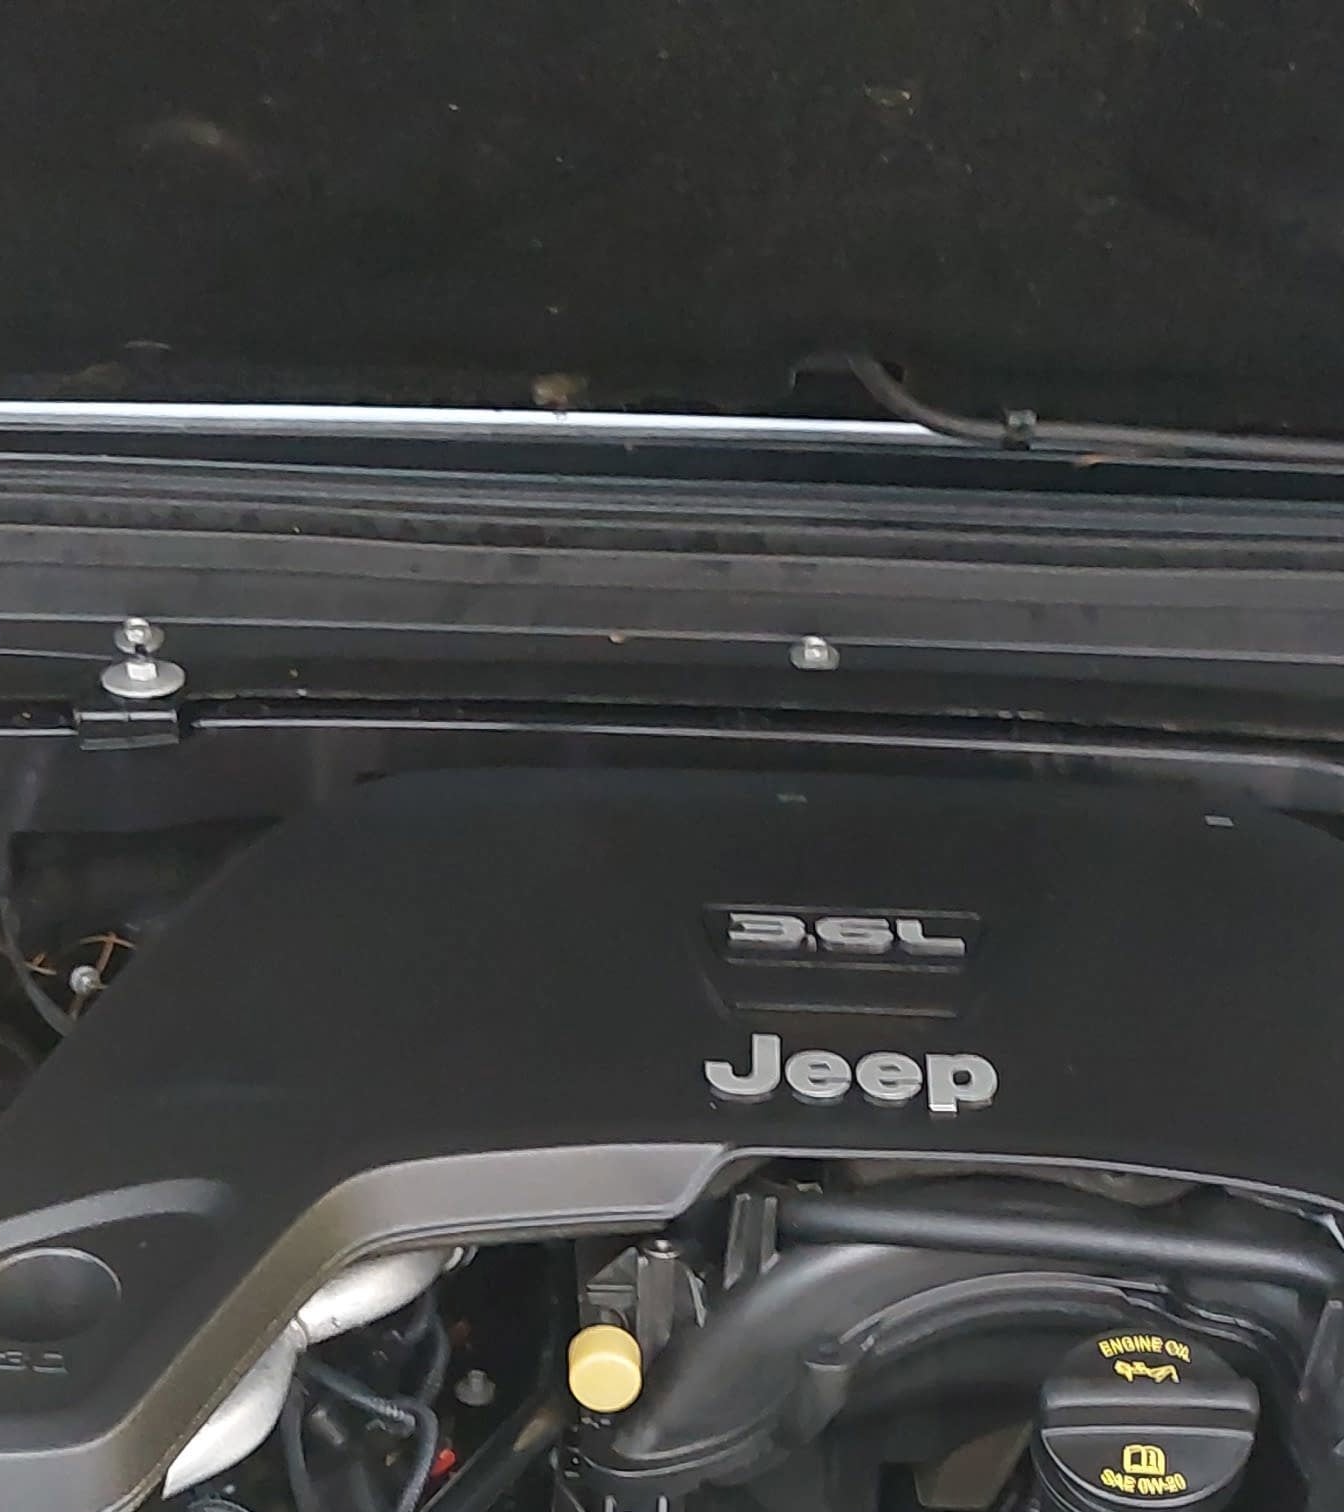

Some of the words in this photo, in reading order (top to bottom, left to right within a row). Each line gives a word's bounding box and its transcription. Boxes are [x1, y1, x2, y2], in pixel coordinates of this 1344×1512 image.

[727, 912, 966, 956] 3.6L
[704, 1033, 998, 1113] Jeep
[1097, 1334, 1163, 1358] ENGINE
[1164, 1340, 1192, 1363] OIL
[1099, 1468, 1136, 1493] SAE
[1137, 1473, 1187, 1495] 0W-20
